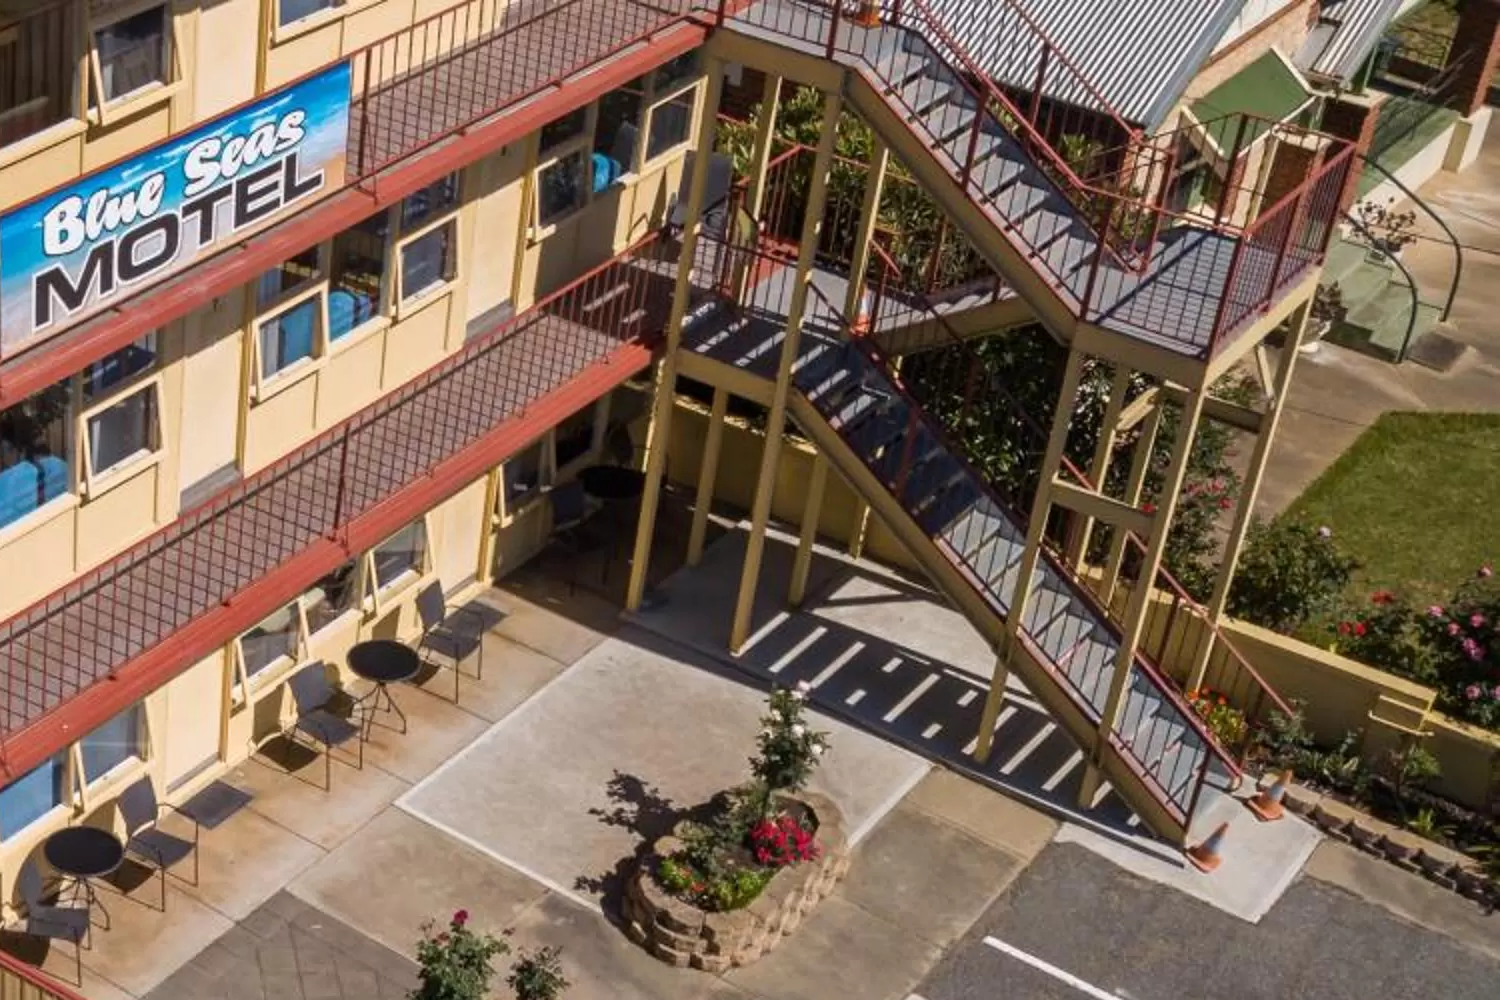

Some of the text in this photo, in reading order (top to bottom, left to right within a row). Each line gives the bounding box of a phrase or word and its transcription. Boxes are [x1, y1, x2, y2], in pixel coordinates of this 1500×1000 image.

[32, 153, 324, 331] MOTEL
[42, 109, 305, 256] Blue Seas
